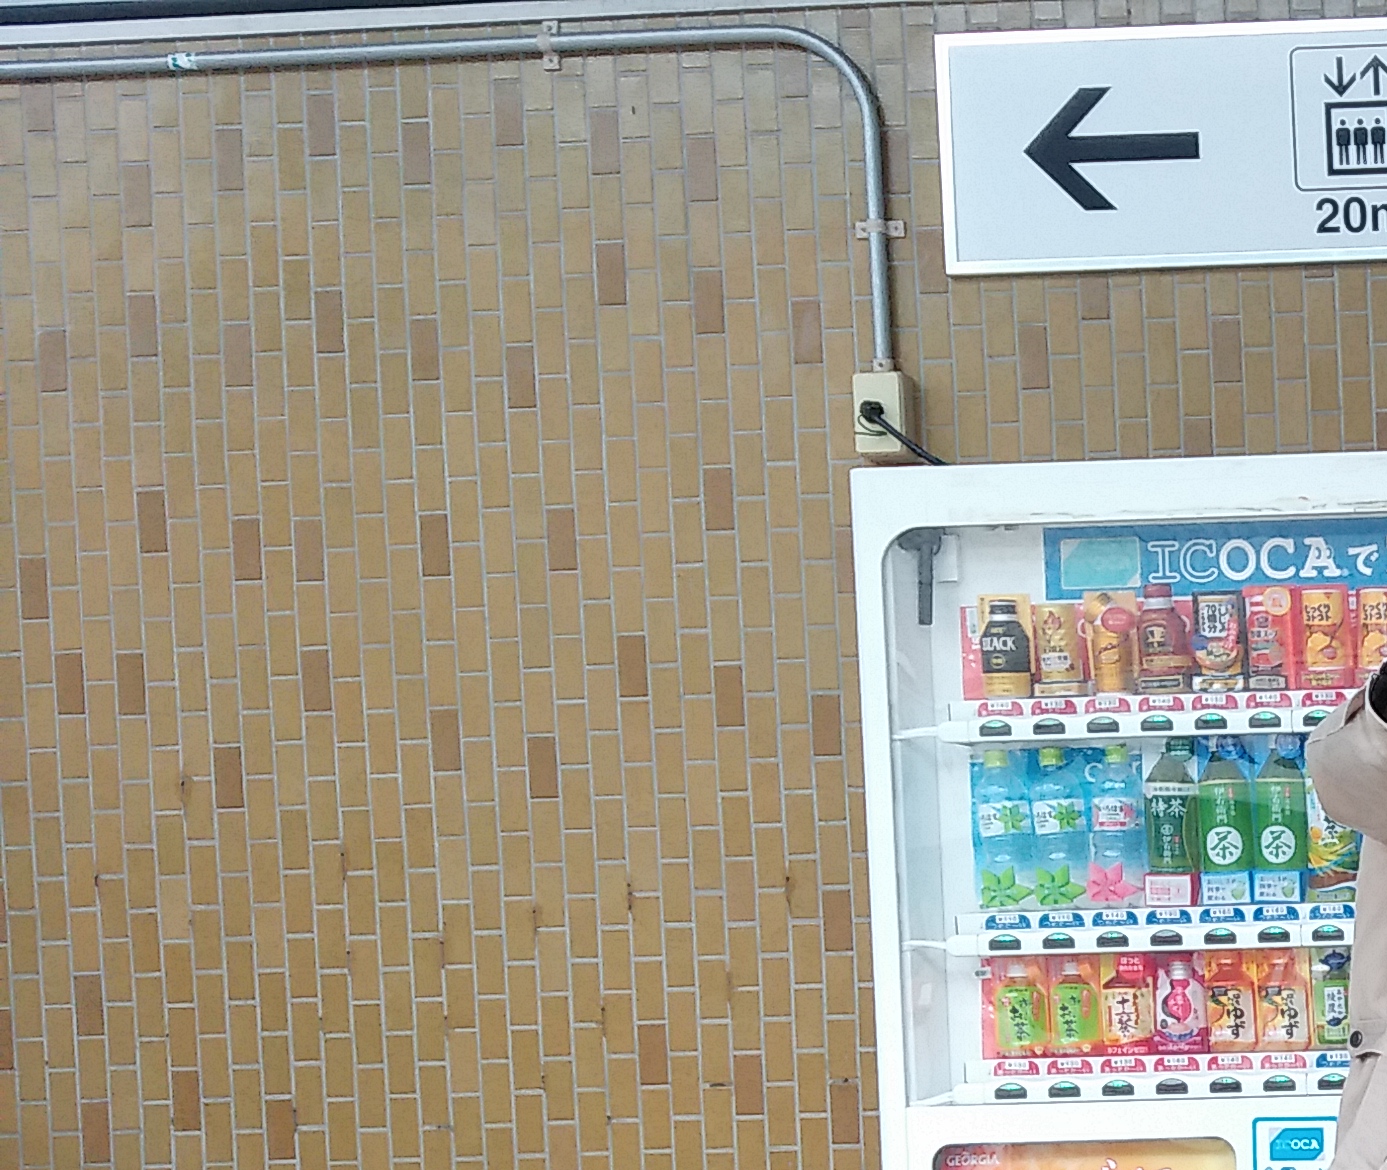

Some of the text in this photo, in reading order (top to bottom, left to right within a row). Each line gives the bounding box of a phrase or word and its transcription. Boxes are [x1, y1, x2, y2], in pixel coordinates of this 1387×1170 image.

[1150, 797, 1188, 818] 特茶
[1210, 830, 1240, 861] 茶
[1264, 830, 1293, 860] 茶
[946, 1153, 1000, 1167] GEORGIA
